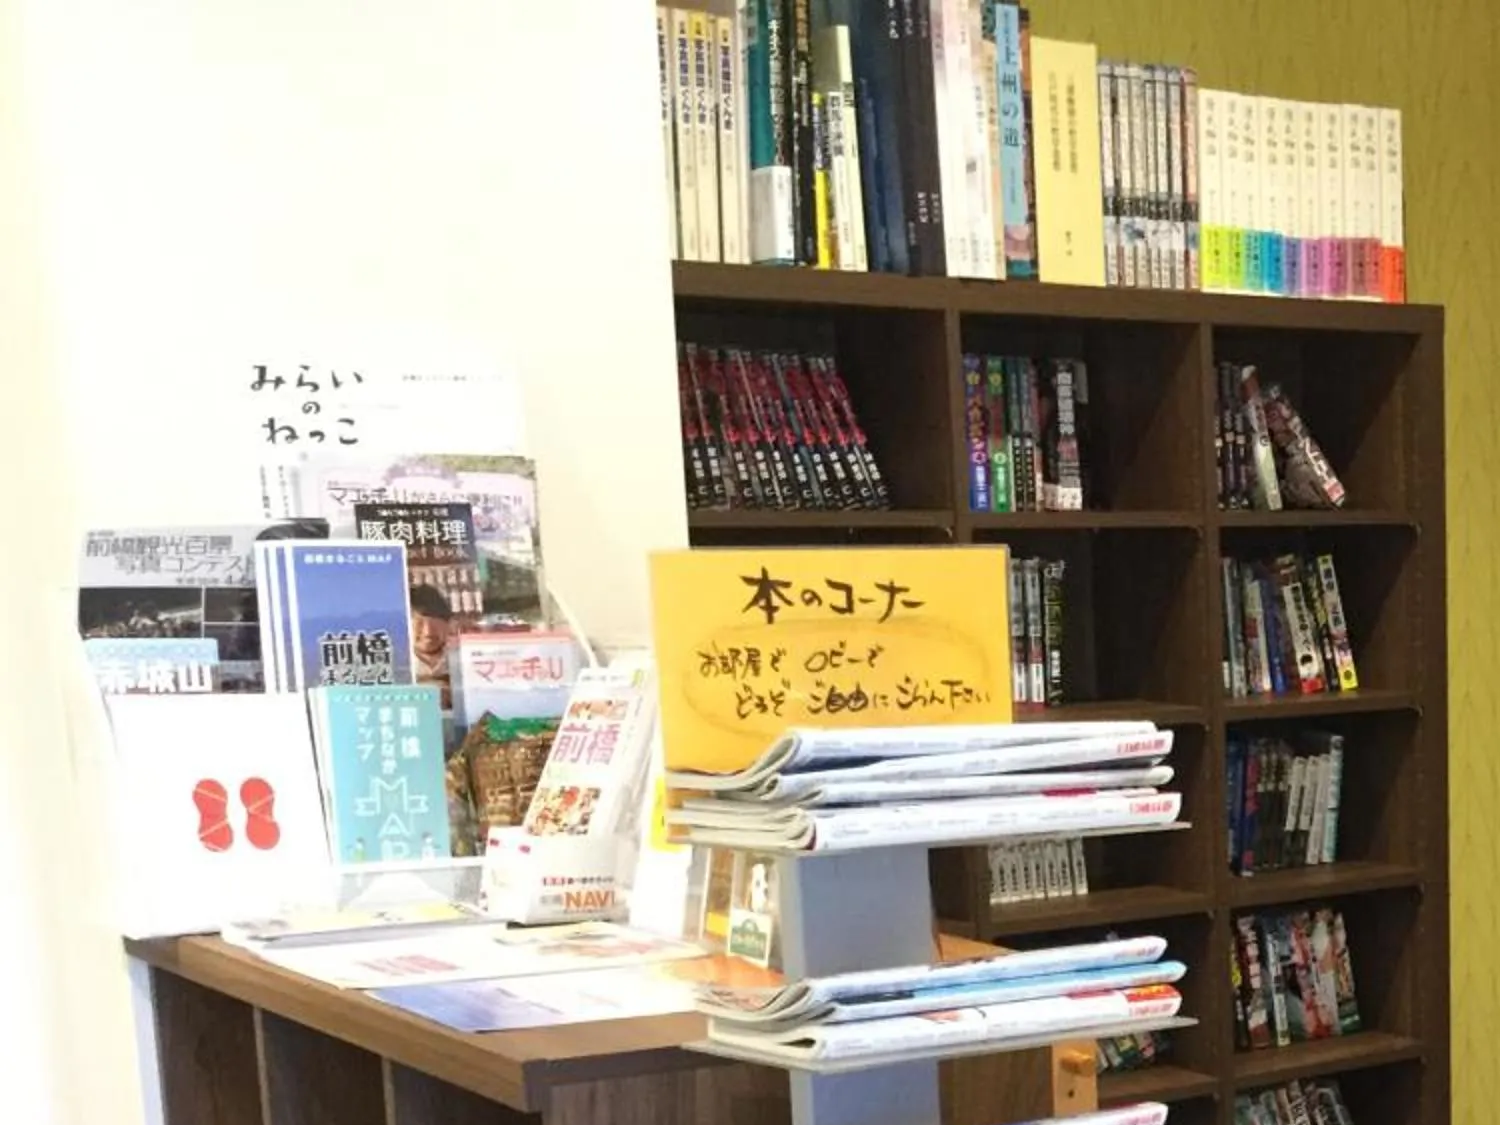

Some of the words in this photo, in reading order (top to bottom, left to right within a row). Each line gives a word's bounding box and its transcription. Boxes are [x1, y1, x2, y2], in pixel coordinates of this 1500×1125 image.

[1002, 46, 1020, 147] 上州の道
[250, 364, 363, 392] みらい
[302, 401, 321, 415] の
[261, 417, 358, 445] ねっこ
[361, 519, 469, 545] 豚肉料理
[739, 565, 926, 625] 本のコーナー
[321, 631, 392, 667] 前橋
[697, 640, 787, 678] お部屋で
[804, 640, 884, 673] ロビーで
[735, 678, 791, 719] どうぞ
[807, 680, 889, 715] ご自由に
[896, 675, 992, 710] ごらん下さい
[355, 706, 375, 761] マップ
[379, 706, 397, 775] まちなか
[552, 722, 621, 766] 前橋
[564, 889, 615, 909] NAVI
